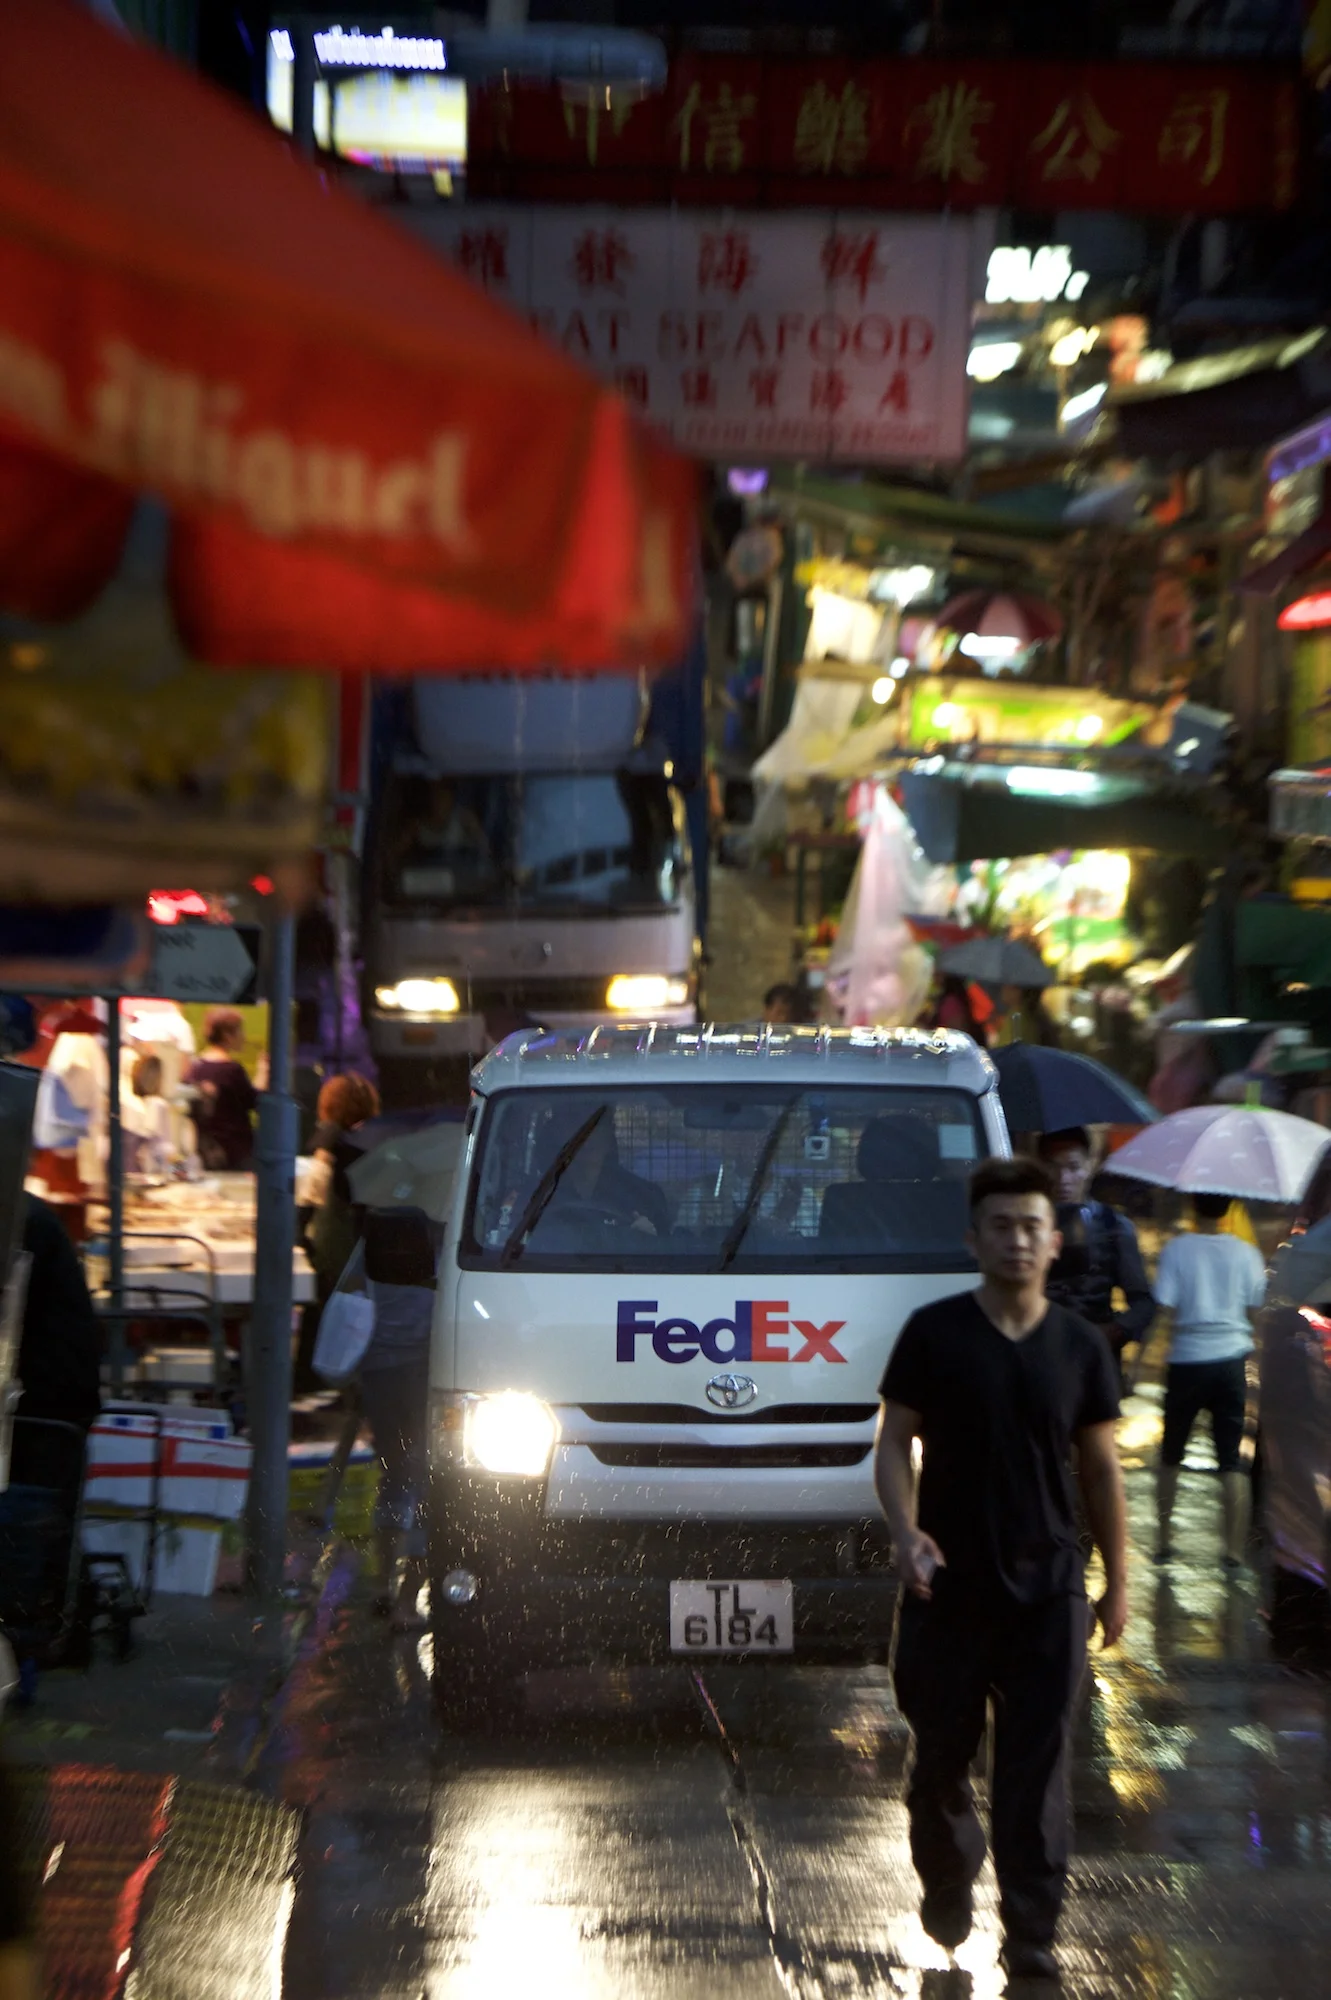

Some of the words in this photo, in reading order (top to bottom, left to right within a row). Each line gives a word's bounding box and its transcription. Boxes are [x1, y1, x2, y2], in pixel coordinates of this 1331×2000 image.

[657, 310, 935, 365] SEAFOOD
[616, 1300, 848, 1364] FedEx
[705, 1583, 757, 1615] TL
[684, 1614, 779, 1647] 6184
